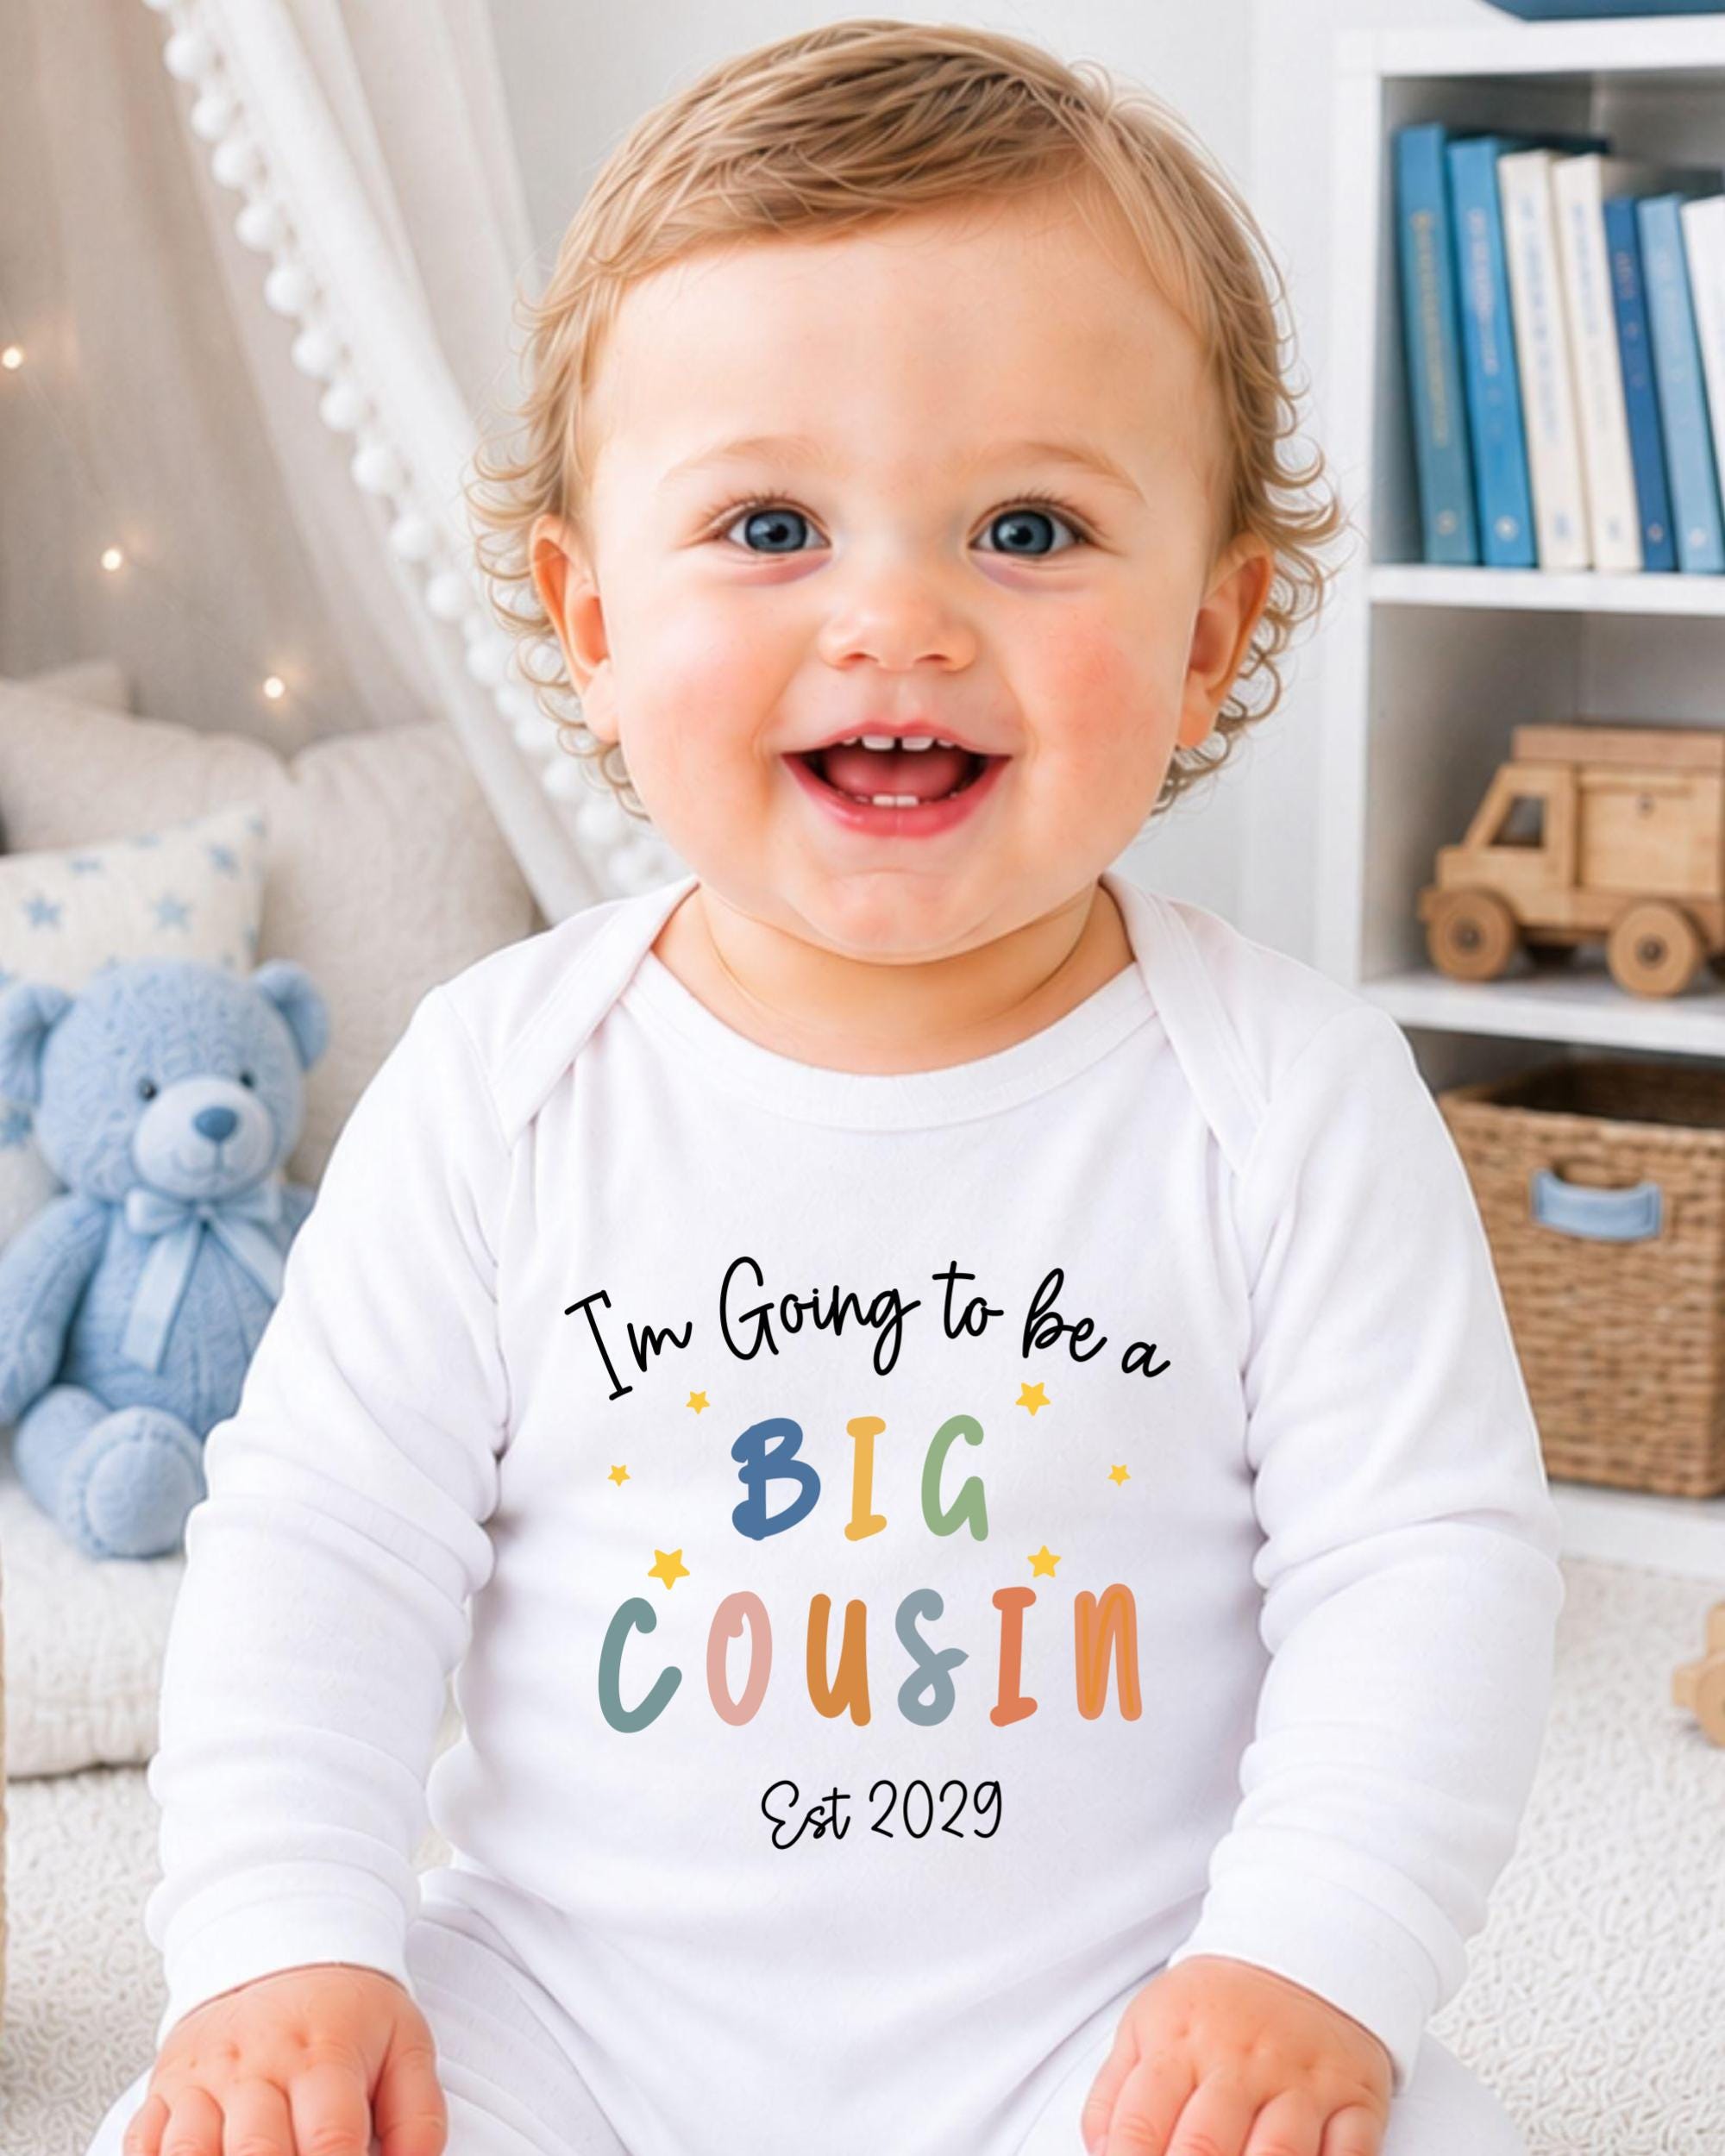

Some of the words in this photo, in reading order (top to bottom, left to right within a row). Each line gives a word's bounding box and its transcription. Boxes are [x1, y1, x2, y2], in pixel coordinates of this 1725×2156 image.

[719, 1256, 922, 1376] Going
[932, 1260, 1005, 1339] to
[1022, 1268, 1108, 1363] be
[1120, 1341, 1171, 1378] a
[731, 1414, 989, 1542] BIG
[598, 1583, 1143, 1733] COUSIN
[761, 1779, 851, 1851] Est
[869, 1779, 1003, 1839] 2029
